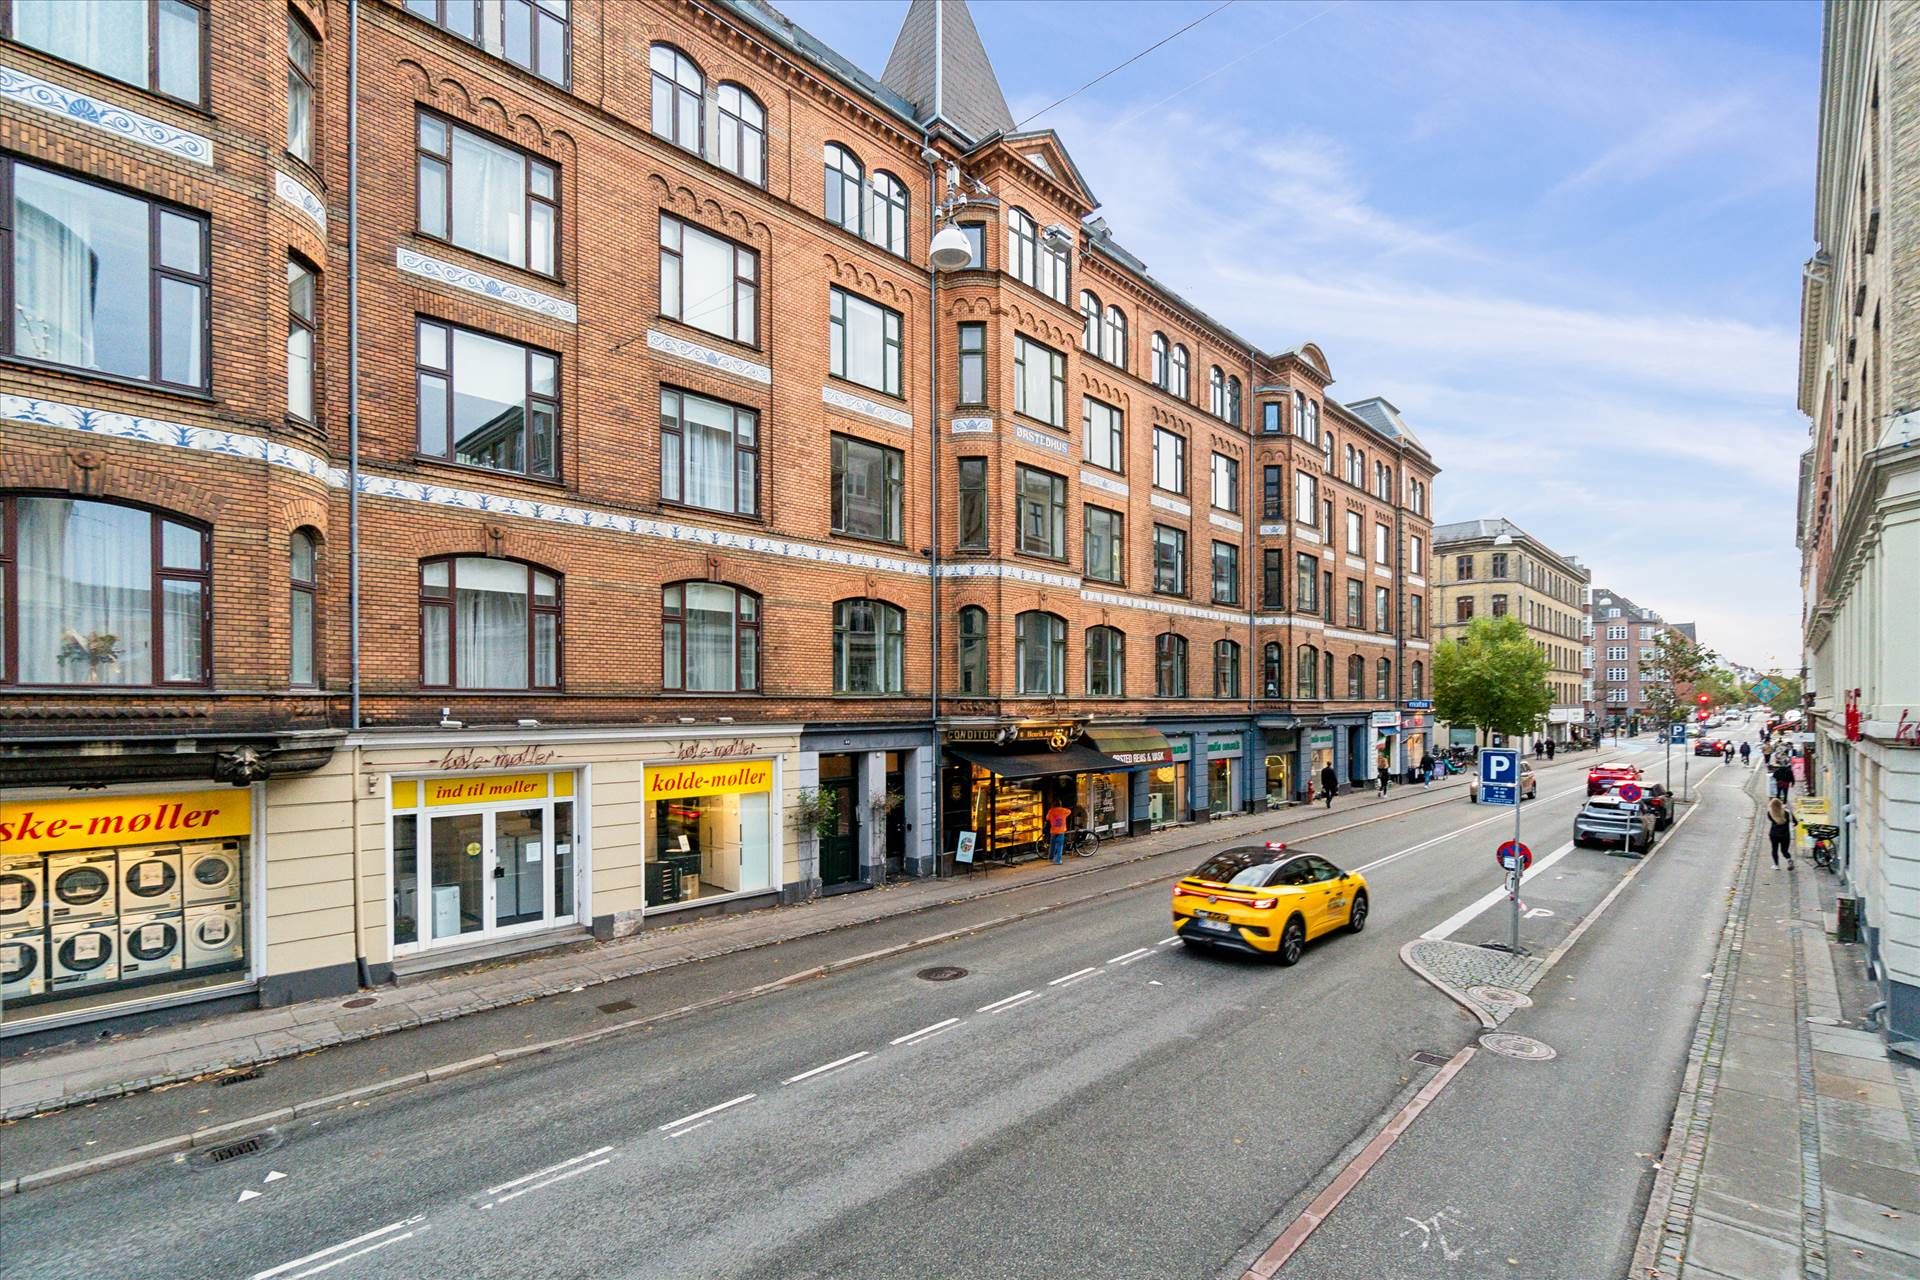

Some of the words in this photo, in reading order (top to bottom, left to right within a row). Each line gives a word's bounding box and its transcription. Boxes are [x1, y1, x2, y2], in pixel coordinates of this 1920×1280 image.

[1673, 725, 1683, 736] P
[1490, 755, 1510, 780] P
[436, 784, 464, 799] ind
[467, 783, 486, 797] til
[489, 780, 538, 796] møller
[652, 768, 766, 792] kolde-møller
[0, 803, 220, 842] ske-møller
[1523, 908, 1555, 919] P
